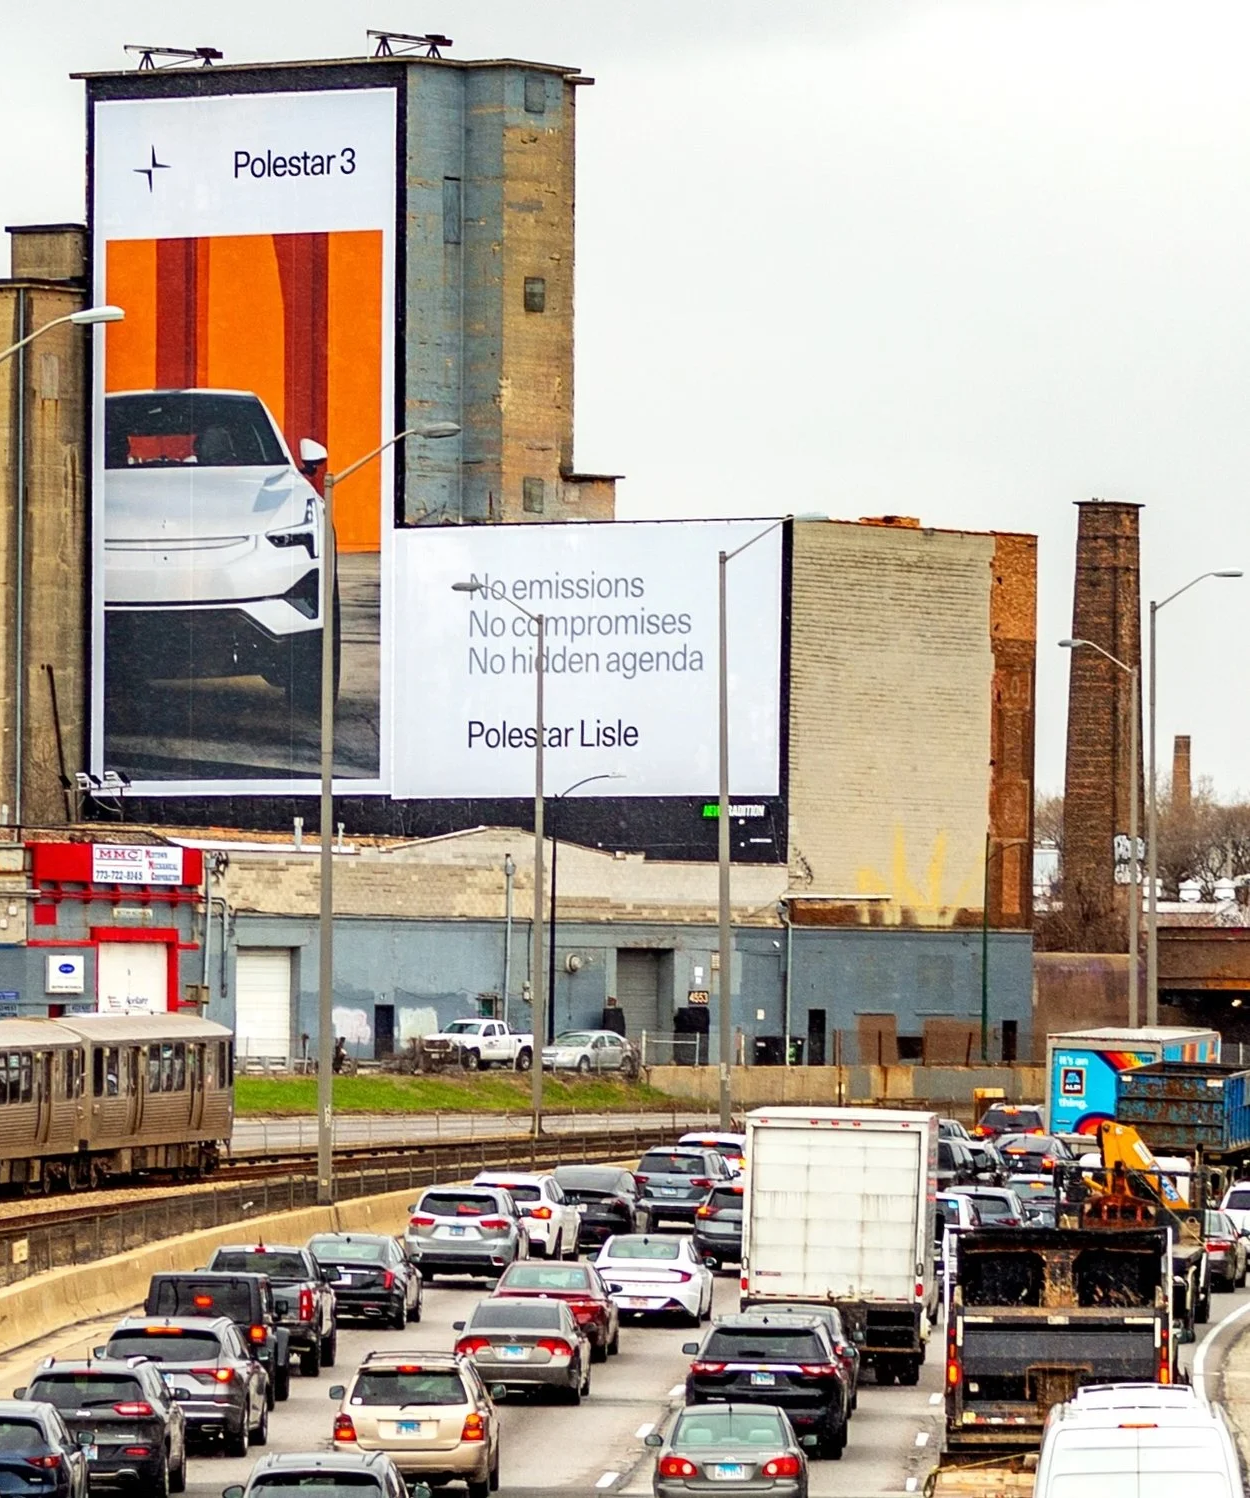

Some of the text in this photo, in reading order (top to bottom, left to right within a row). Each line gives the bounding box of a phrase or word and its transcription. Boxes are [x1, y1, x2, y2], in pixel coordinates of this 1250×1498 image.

[234, 147, 356, 179] Polestar 3
[469, 571, 645, 601] No emissions
[469, 607, 692, 643] No compromises
[468, 644, 704, 680] No hidden agenda
[580, 719, 639, 748] Lisle
[728, 804, 765, 817] RADITION
[99, 850, 139, 859] MMC
[1058, 1055, 1089, 1066] It's an
[1058, 1098, 1089, 1111] thing.
